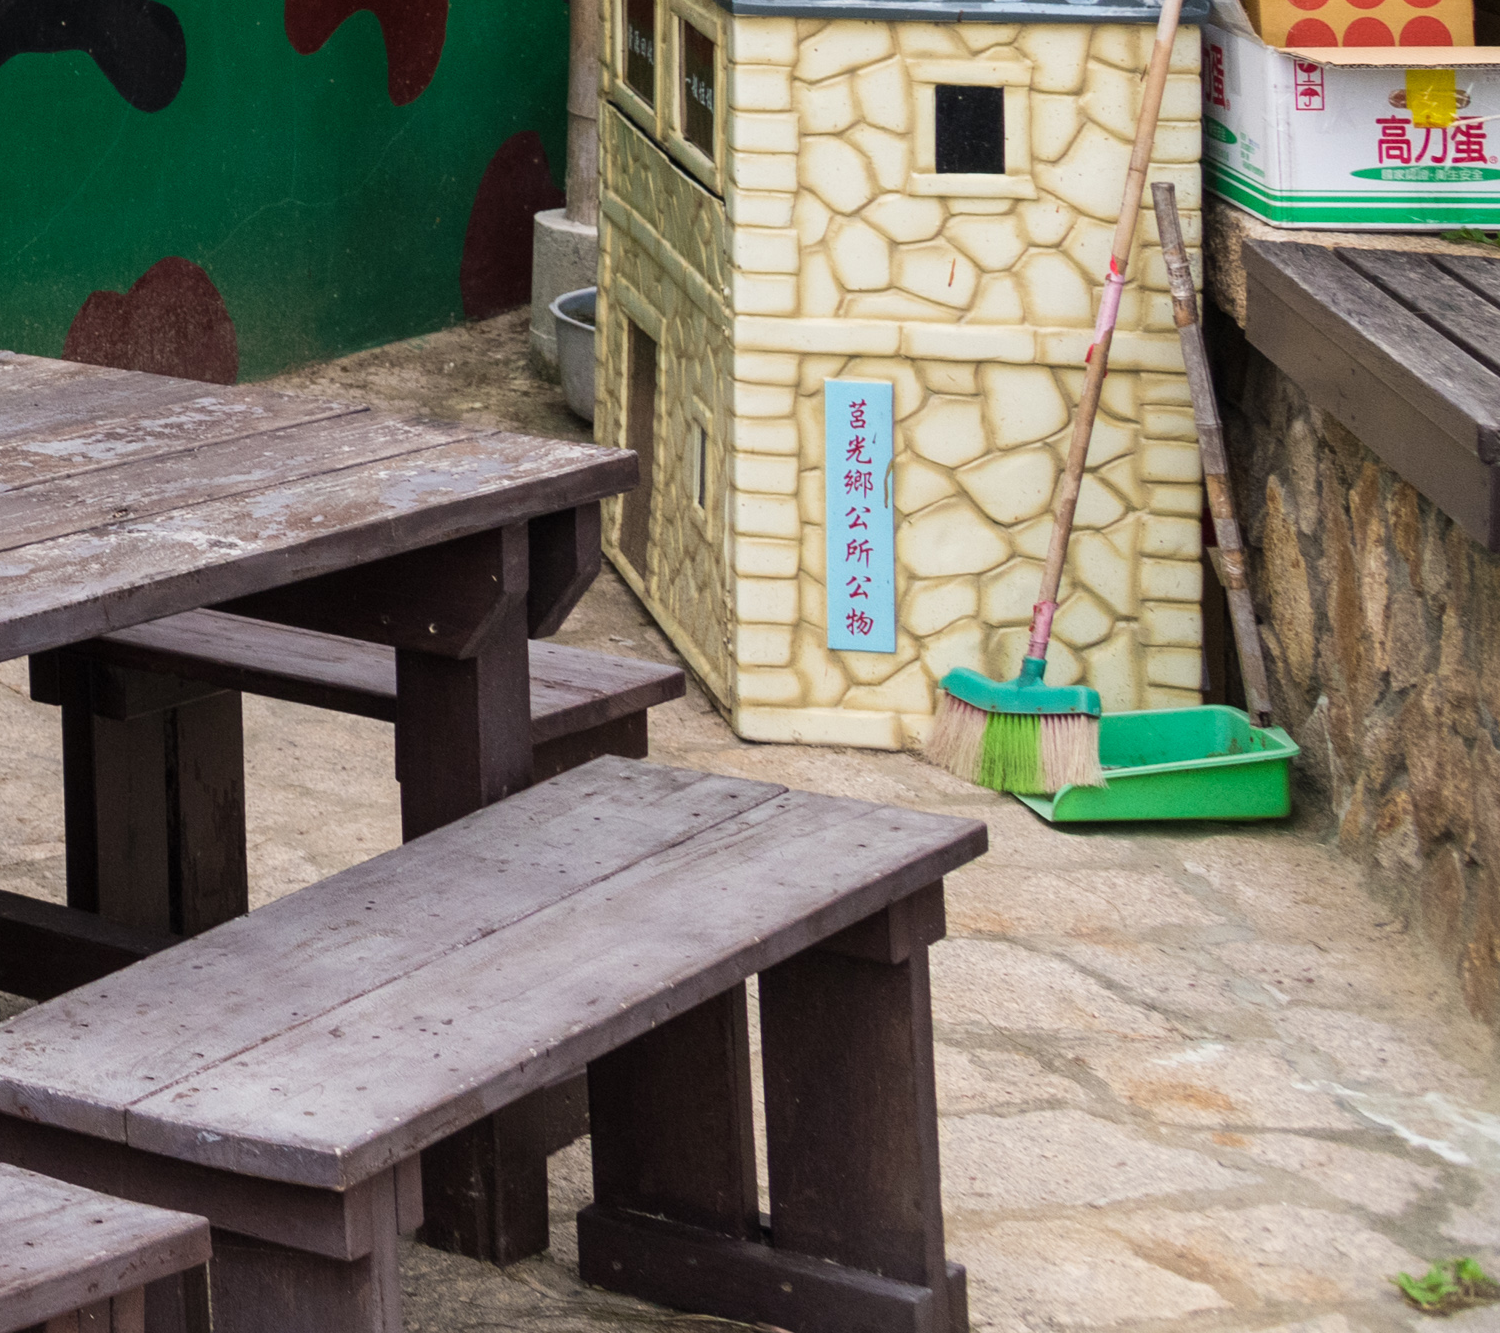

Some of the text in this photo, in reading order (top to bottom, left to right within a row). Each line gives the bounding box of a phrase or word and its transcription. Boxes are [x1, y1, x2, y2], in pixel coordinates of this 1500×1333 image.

[843, 398, 875, 636] 莒光鄉公所公物
